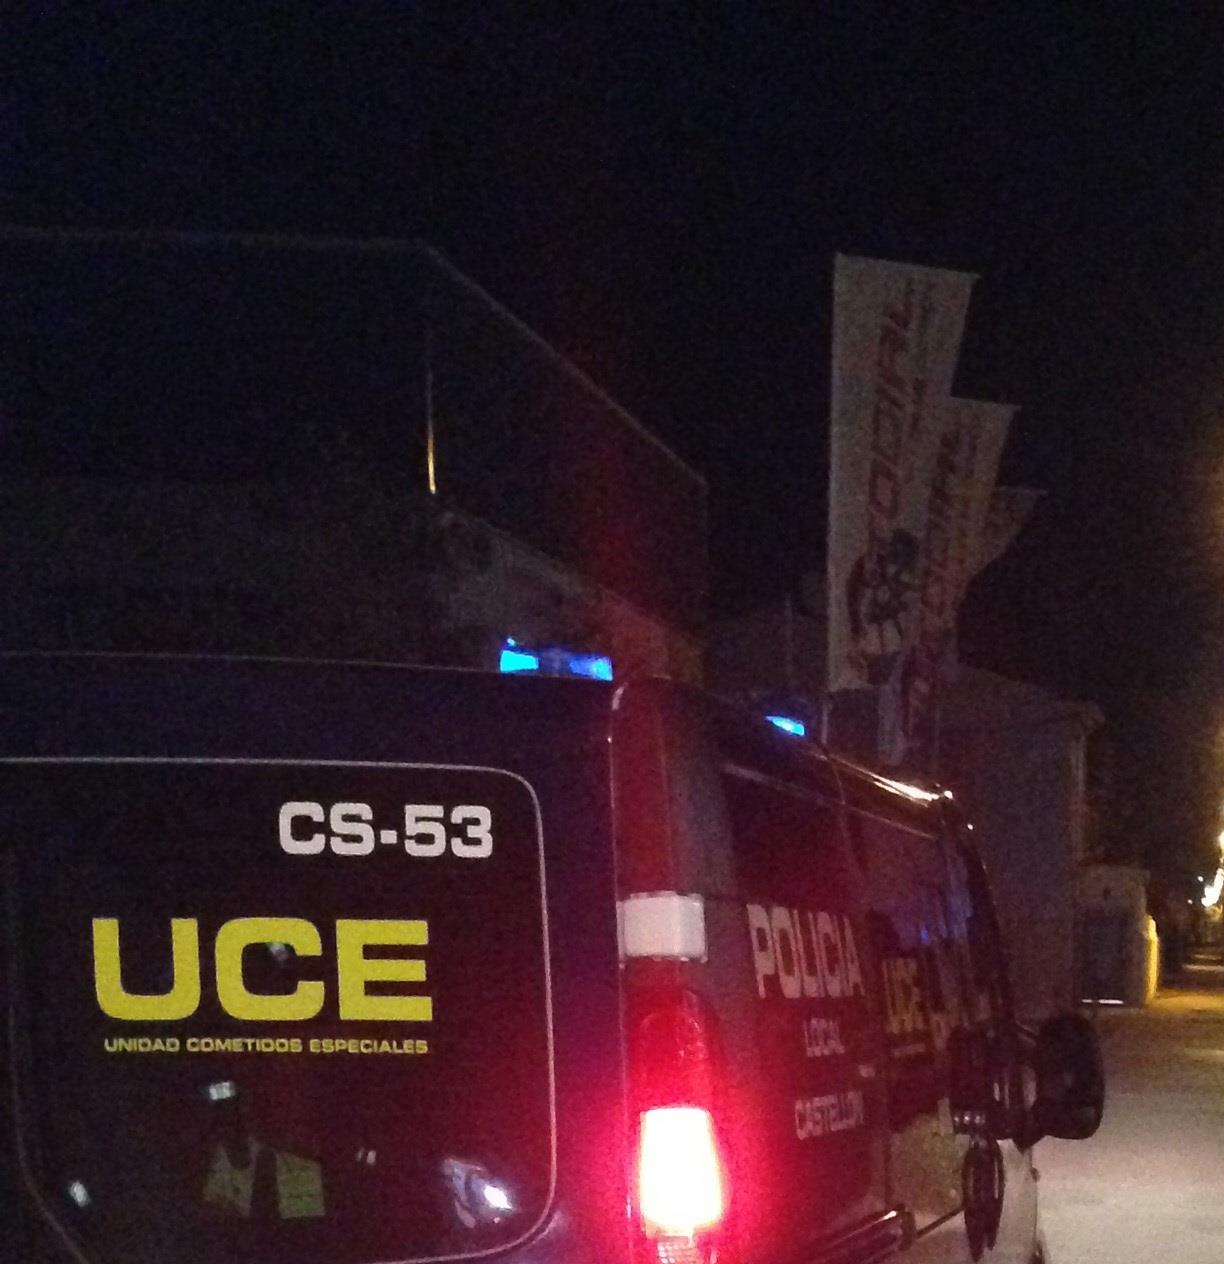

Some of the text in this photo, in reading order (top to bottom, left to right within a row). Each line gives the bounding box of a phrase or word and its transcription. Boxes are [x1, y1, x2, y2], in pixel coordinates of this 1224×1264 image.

[279, 801, 493, 858] CS-53
[92, 917, 433, 1021] UCE
[746, 903, 866, 999] POLICIA
[104, 1038, 428, 1054] UNIDAD COMETIDOS ESPECIALES
